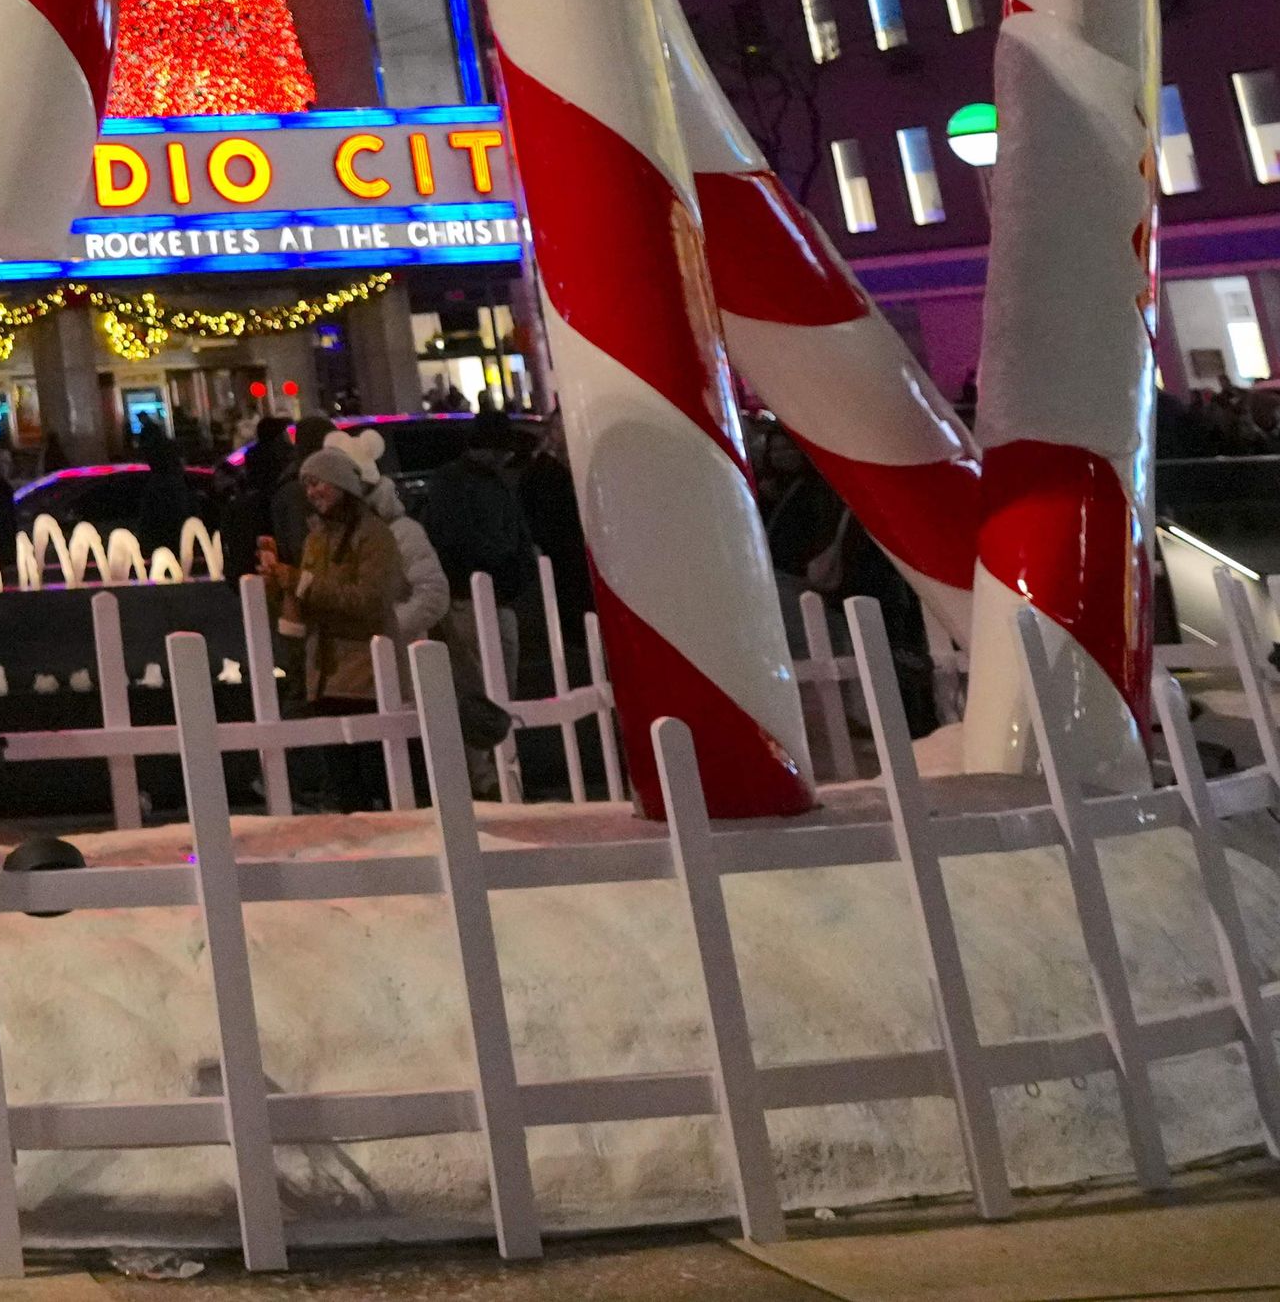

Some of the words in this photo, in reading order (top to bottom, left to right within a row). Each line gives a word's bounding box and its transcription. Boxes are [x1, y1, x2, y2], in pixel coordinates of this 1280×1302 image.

[85, 228, 260, 259] ROCKETTES
[279, 224, 314, 251] AT
[336, 223, 390, 250] THE
